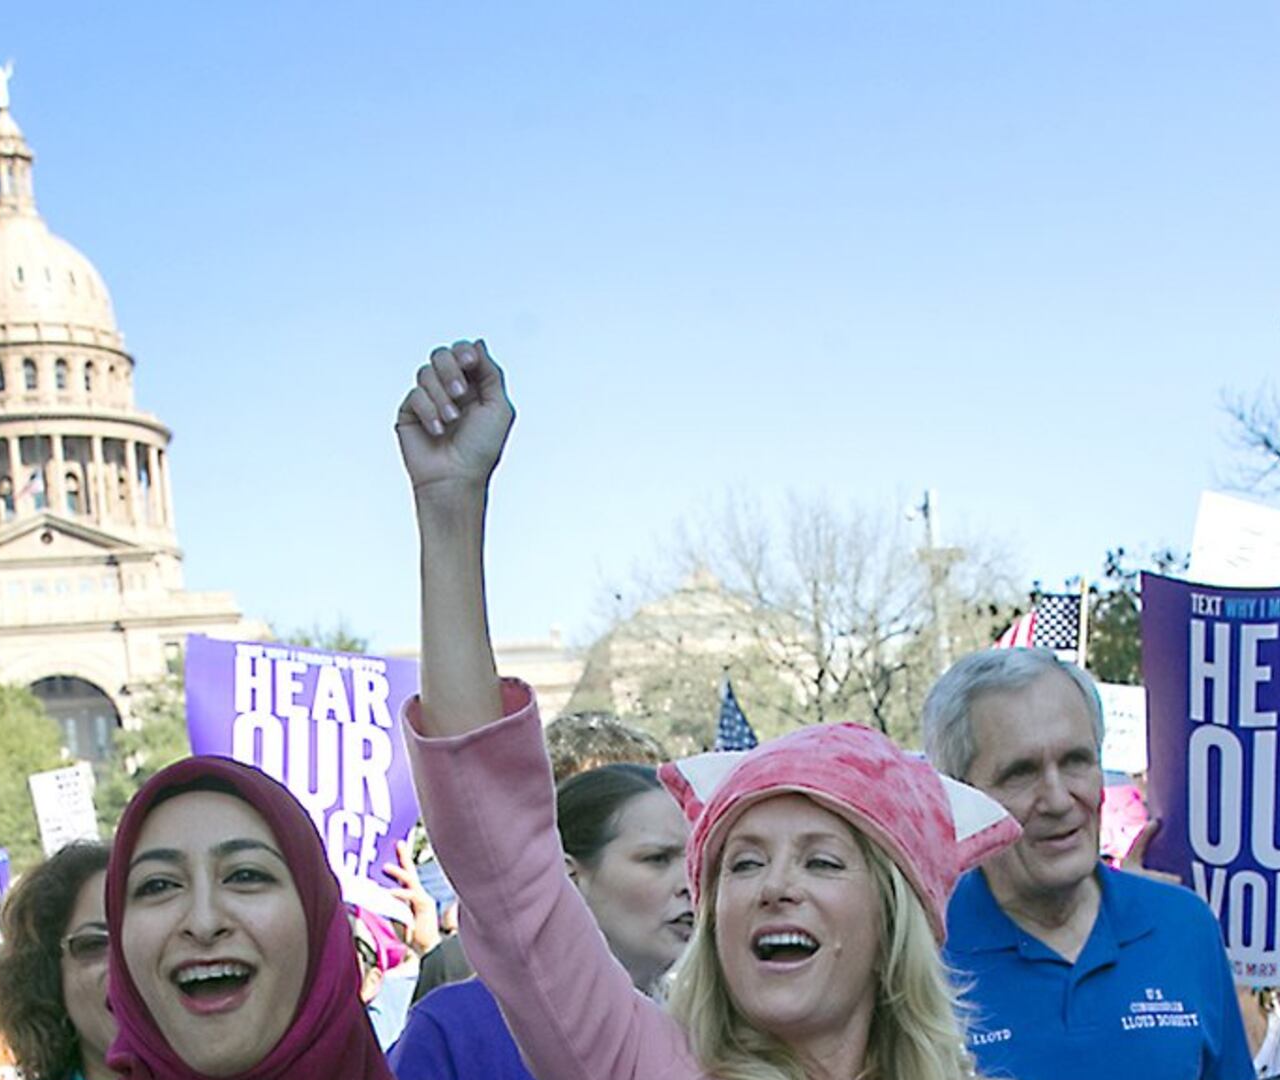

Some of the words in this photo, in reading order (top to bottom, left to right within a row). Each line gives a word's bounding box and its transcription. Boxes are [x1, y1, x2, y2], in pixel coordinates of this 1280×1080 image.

[1190, 592, 1222, 616] TEXT
[1225, 597, 1256, 618] WHY
[1260, 597, 1266, 617] I
[234, 655, 394, 728] HEAR
[232, 713, 393, 823] OUR
